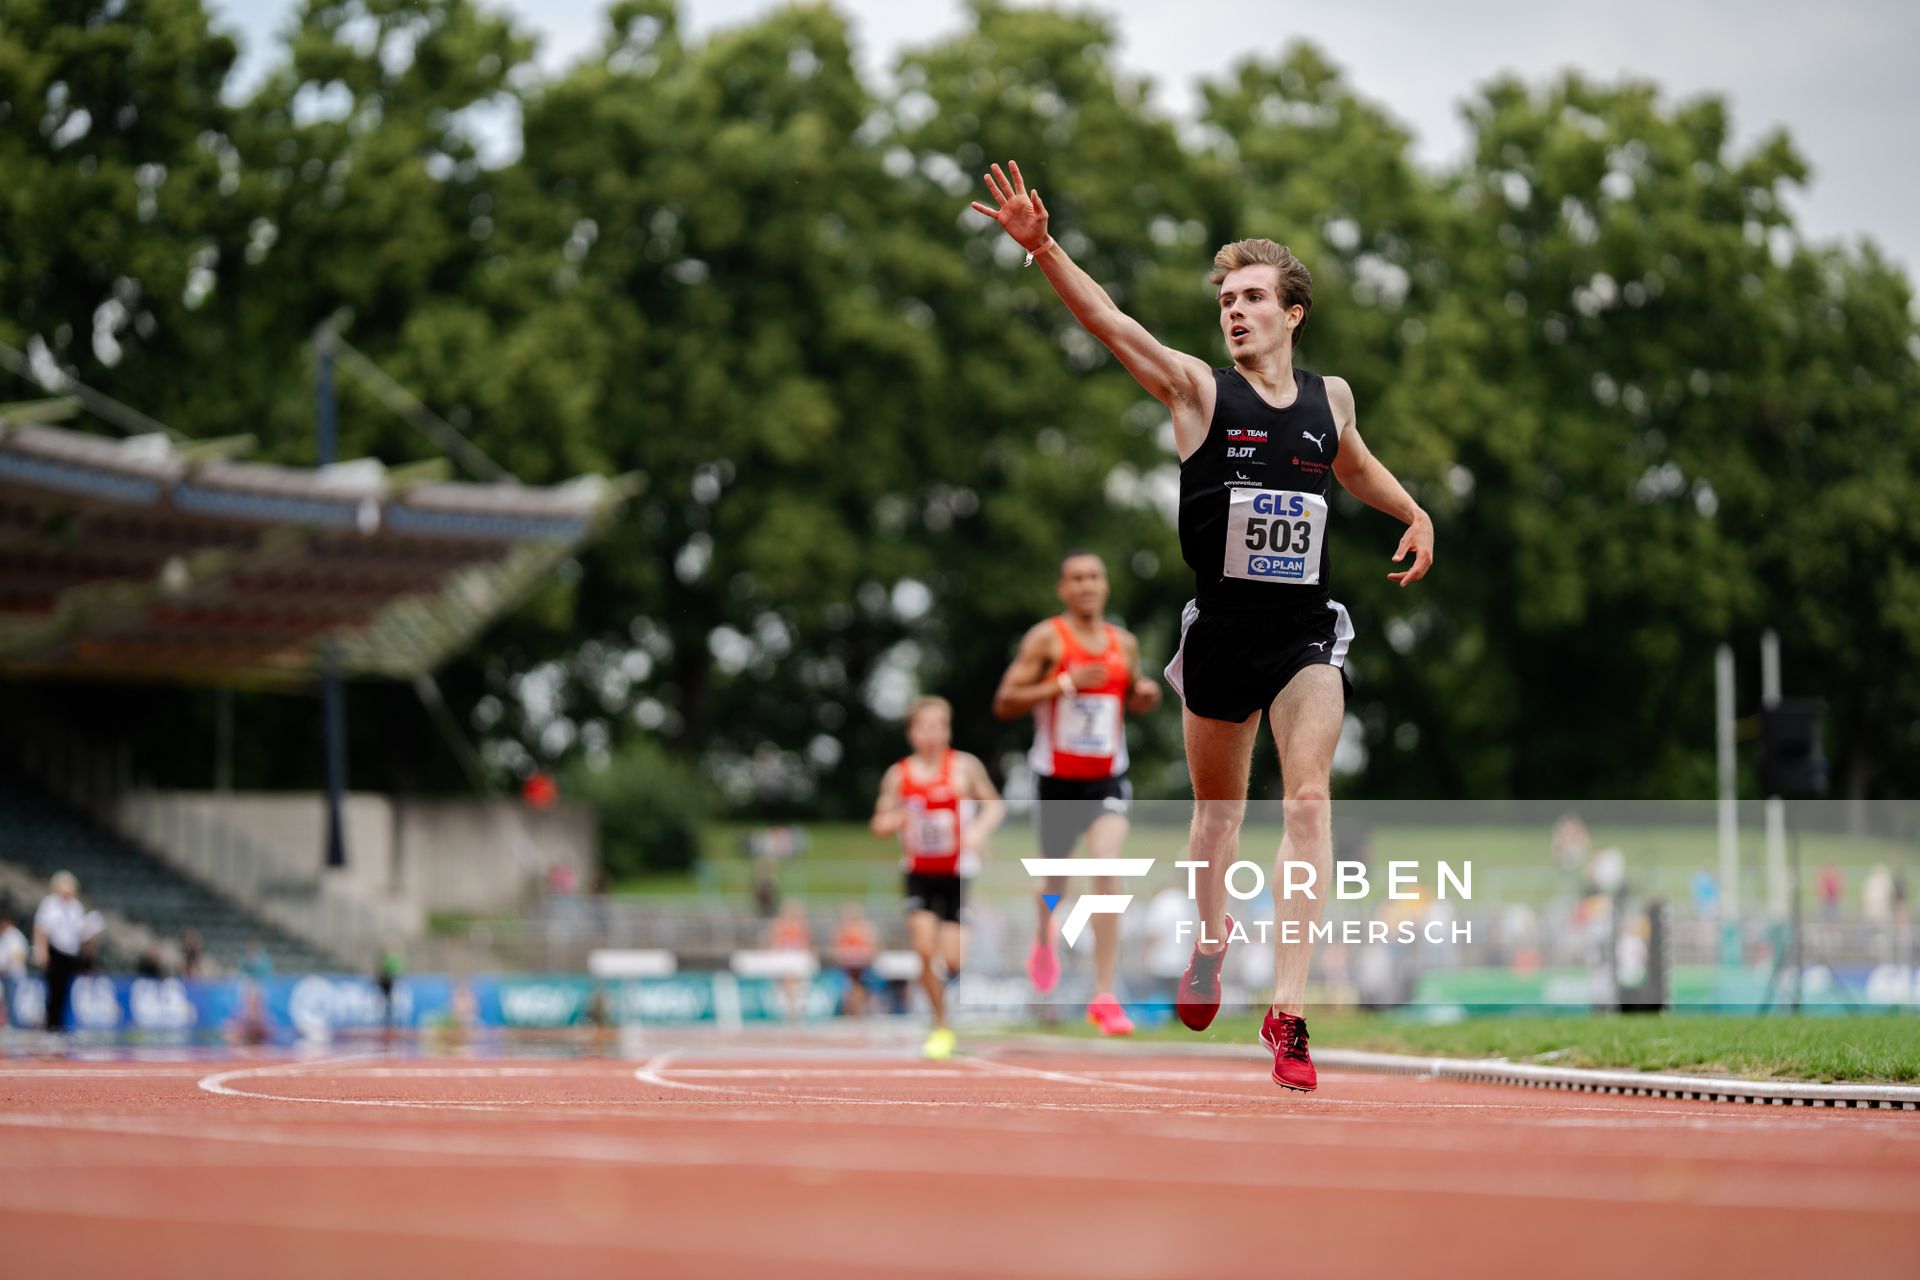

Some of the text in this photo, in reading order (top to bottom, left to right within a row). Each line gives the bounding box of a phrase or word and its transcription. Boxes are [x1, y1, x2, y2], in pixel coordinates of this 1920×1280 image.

[1247, 429, 1268, 437] TEAM
[1227, 447, 1256, 457] B&DT
[1245, 517, 1312, 554] 503
[1272, 560, 1303, 571] PLAN
